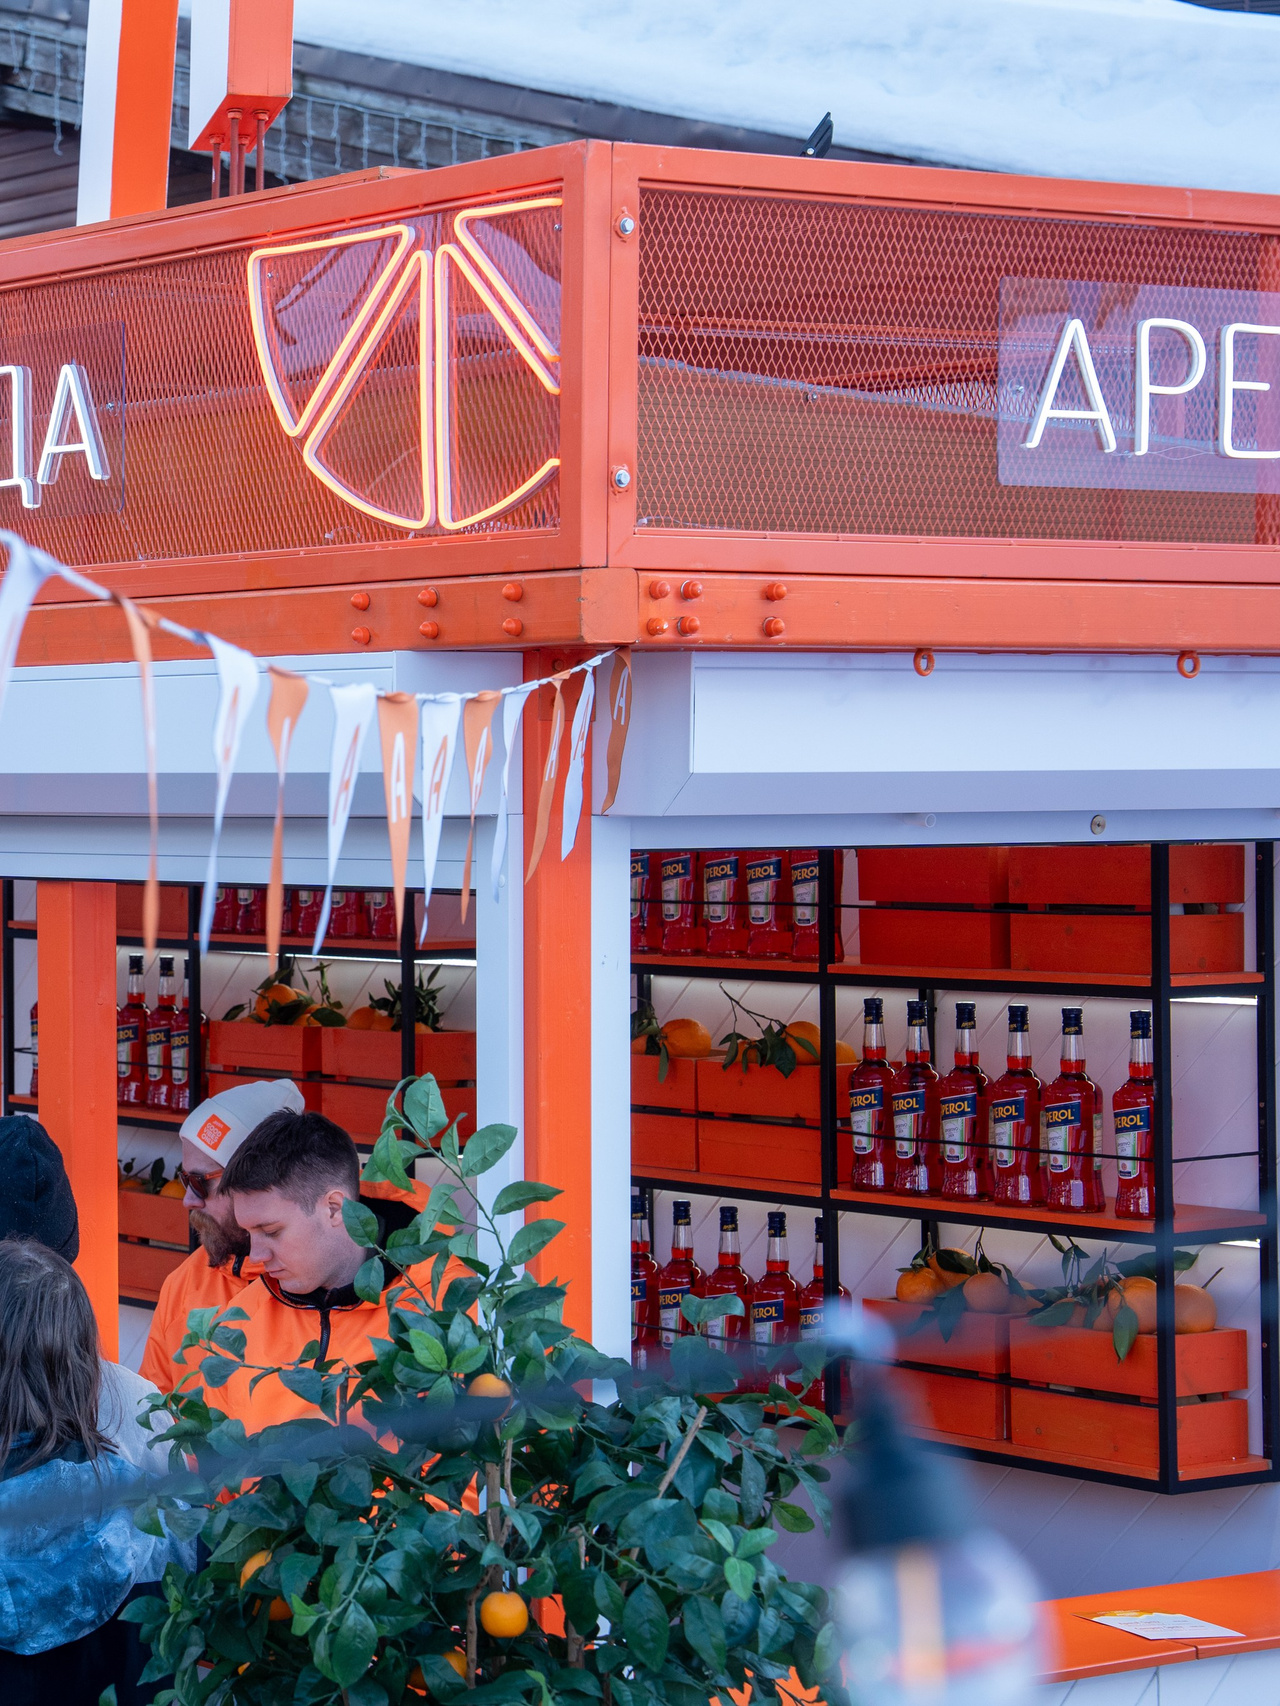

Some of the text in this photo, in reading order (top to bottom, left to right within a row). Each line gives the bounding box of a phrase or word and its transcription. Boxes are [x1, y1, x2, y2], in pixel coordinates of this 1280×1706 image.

[1021, 317, 1280, 460] APE
[613, 666, 629, 725] A
[390, 732, 407, 823] A
[427, 735, 448, 821] A
[662, 862, 685, 877] EROL
[706, 863, 734, 880] PEROL
[850, 1093, 878, 1108] PEROL
[892, 1097, 920, 1111] PEROL
[941, 1100, 971, 1116] PEROL
[1046, 1108, 1075, 1123] PEROL
[1115, 1114, 1144, 1128] PEROL
[753, 1306, 778, 1319] PEROL
